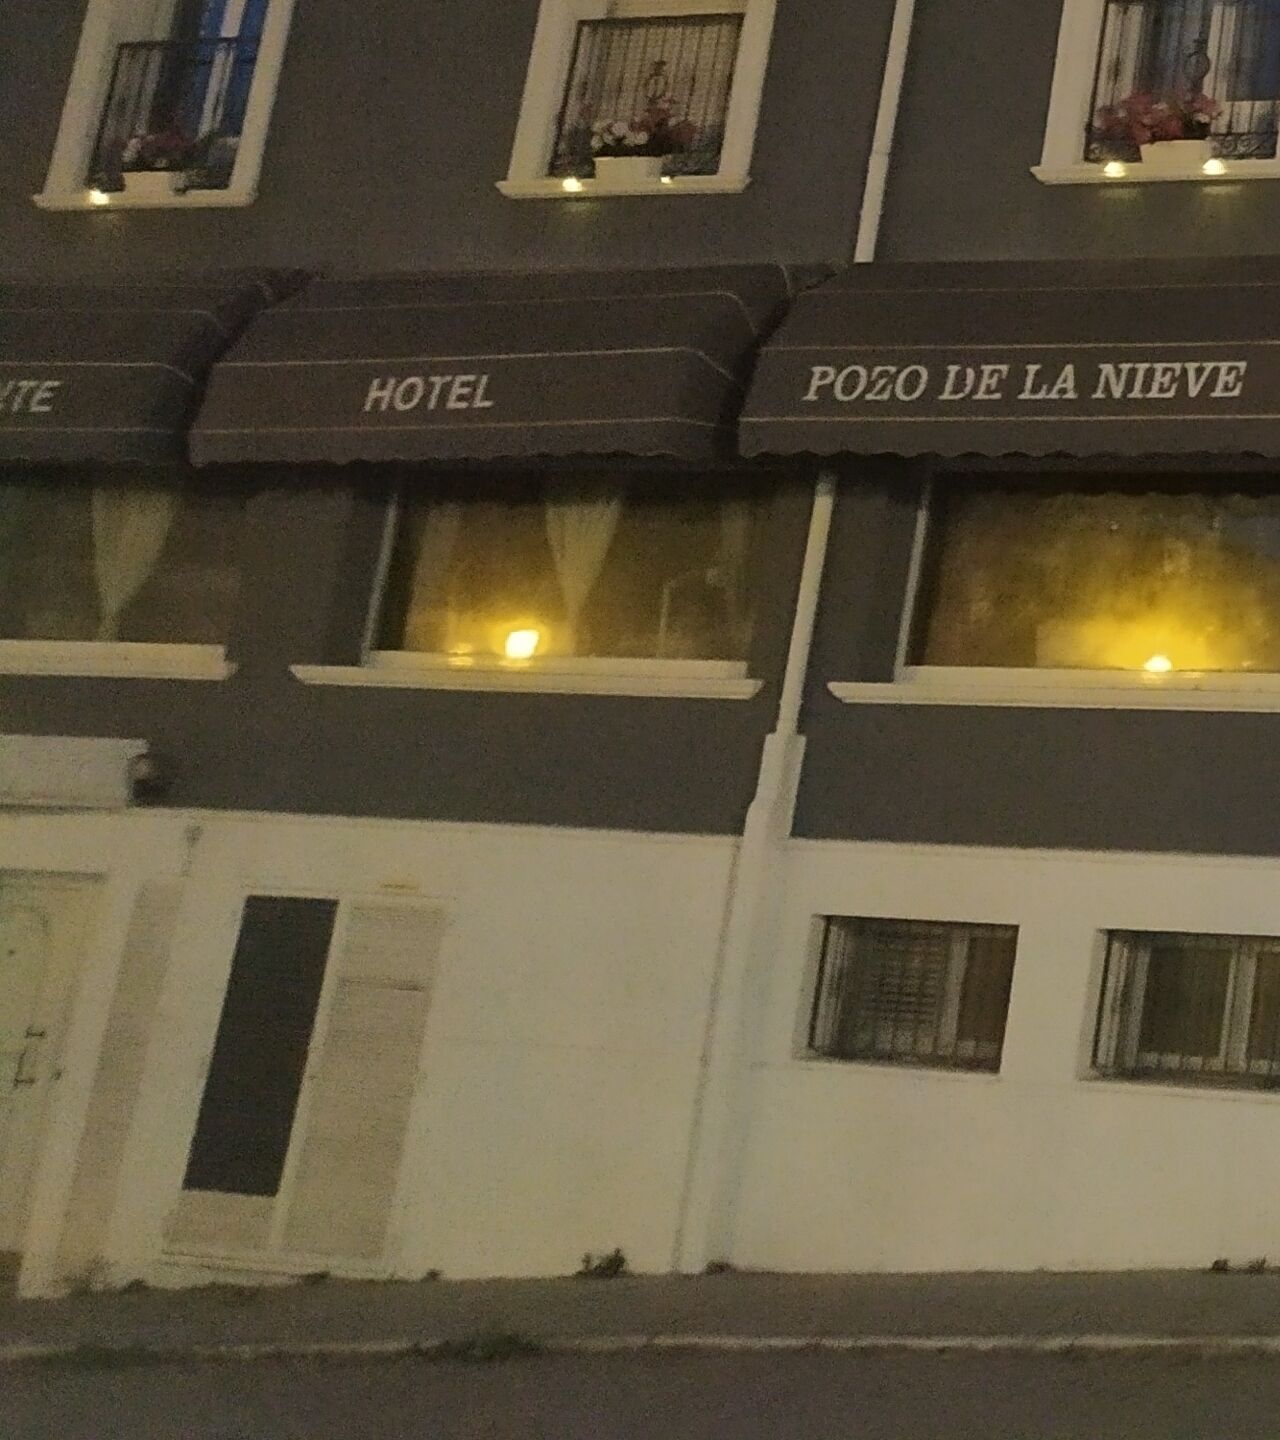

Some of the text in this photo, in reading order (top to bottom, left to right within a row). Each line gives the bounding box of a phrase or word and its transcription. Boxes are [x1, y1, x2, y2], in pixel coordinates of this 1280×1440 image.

[363, 373, 495, 412] HOTEL
[802, 360, 1248, 402] POZO DE LA NIEVE
